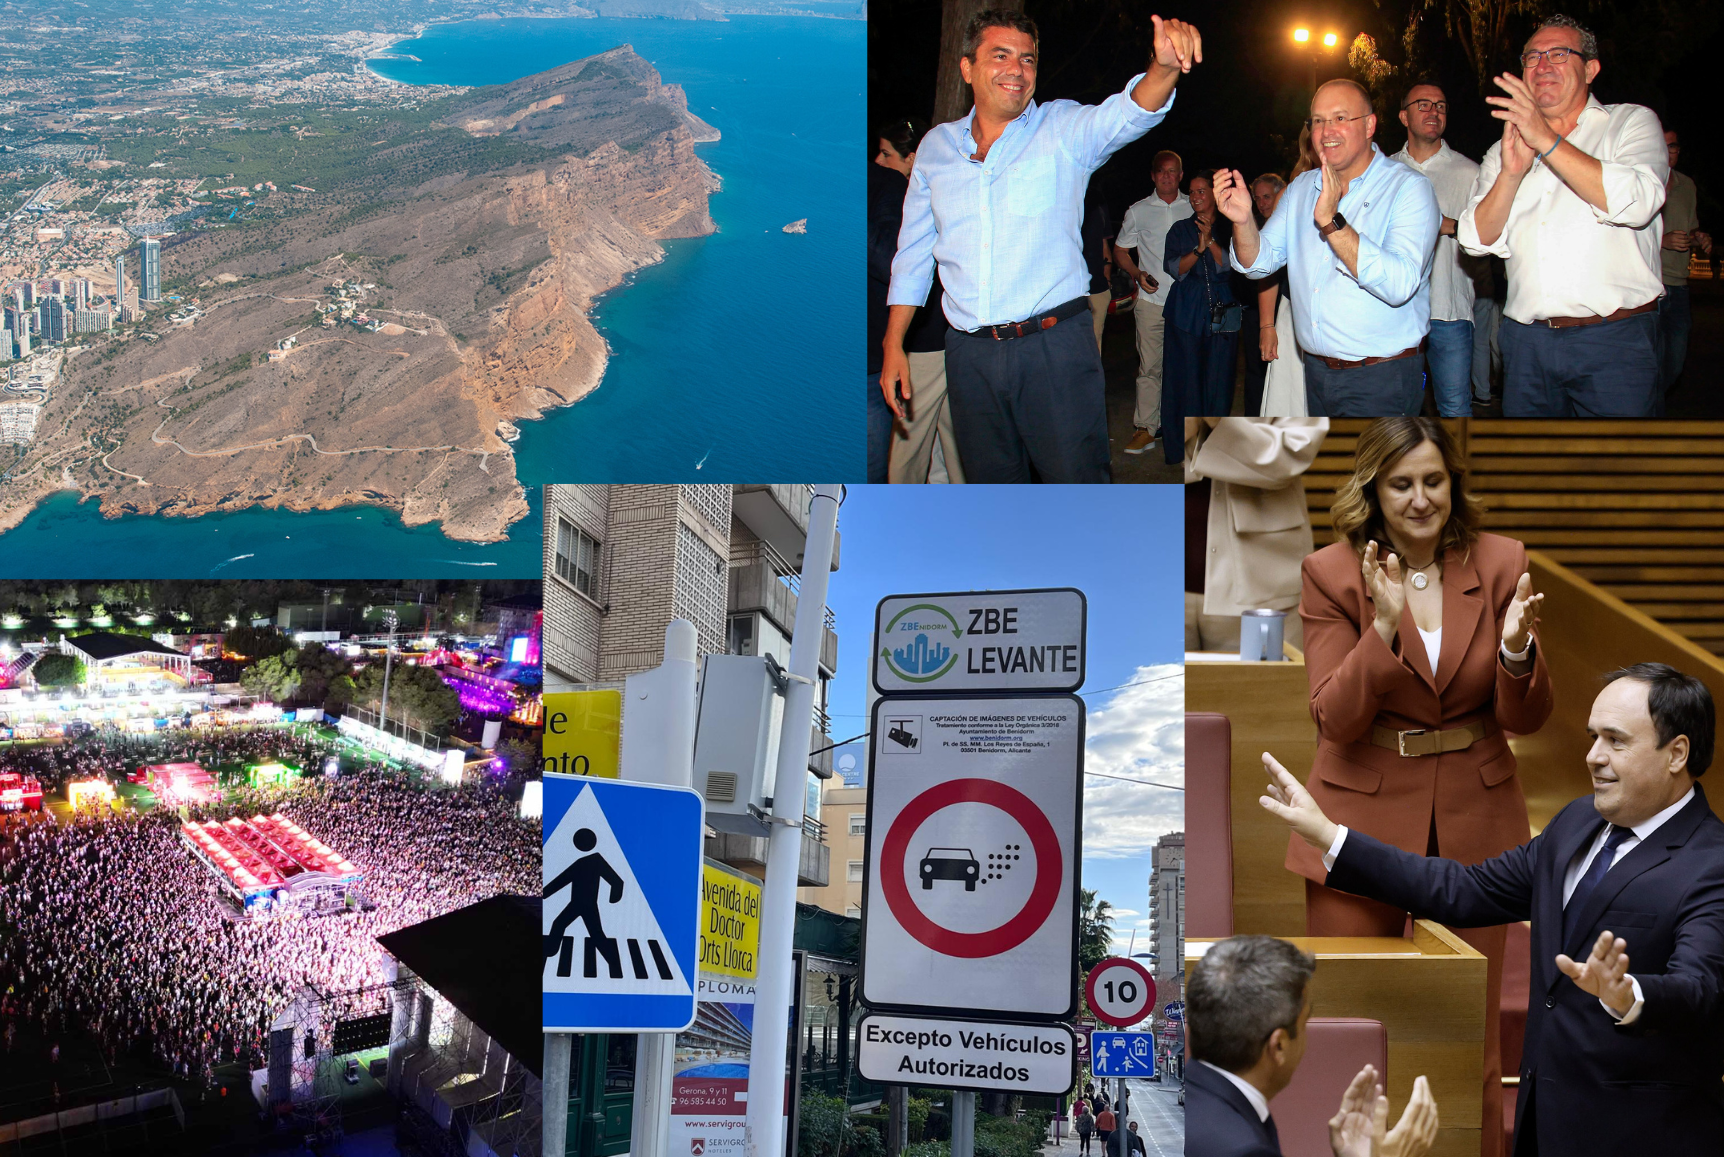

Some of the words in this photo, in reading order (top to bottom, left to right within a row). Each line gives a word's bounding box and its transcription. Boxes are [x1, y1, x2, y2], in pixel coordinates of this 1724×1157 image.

[966, 607, 1018, 635] ZBE
[967, 644, 1078, 674] LEVANTE
[980, 714, 1015, 722] IMÁGENES
[1027, 714, 1067, 722] VEHÍCULOS
[743, 890, 759, 919] del
[710, 907, 745, 941] Doctor
[723, 941, 752, 972] Llorca
[1103, 980, 1137, 1003] 10
[866, 1024, 952, 1050] Excepto
[958, 1031, 1066, 1056] Vehículos
[897, 1055, 1030, 1082] Autorizados
[679, 1086, 708, 1095] Gerona,
[709, 1087, 714, 1095] 9
[679, 1097, 689, 1105] 96
[690, 1097, 704, 1105] 585
